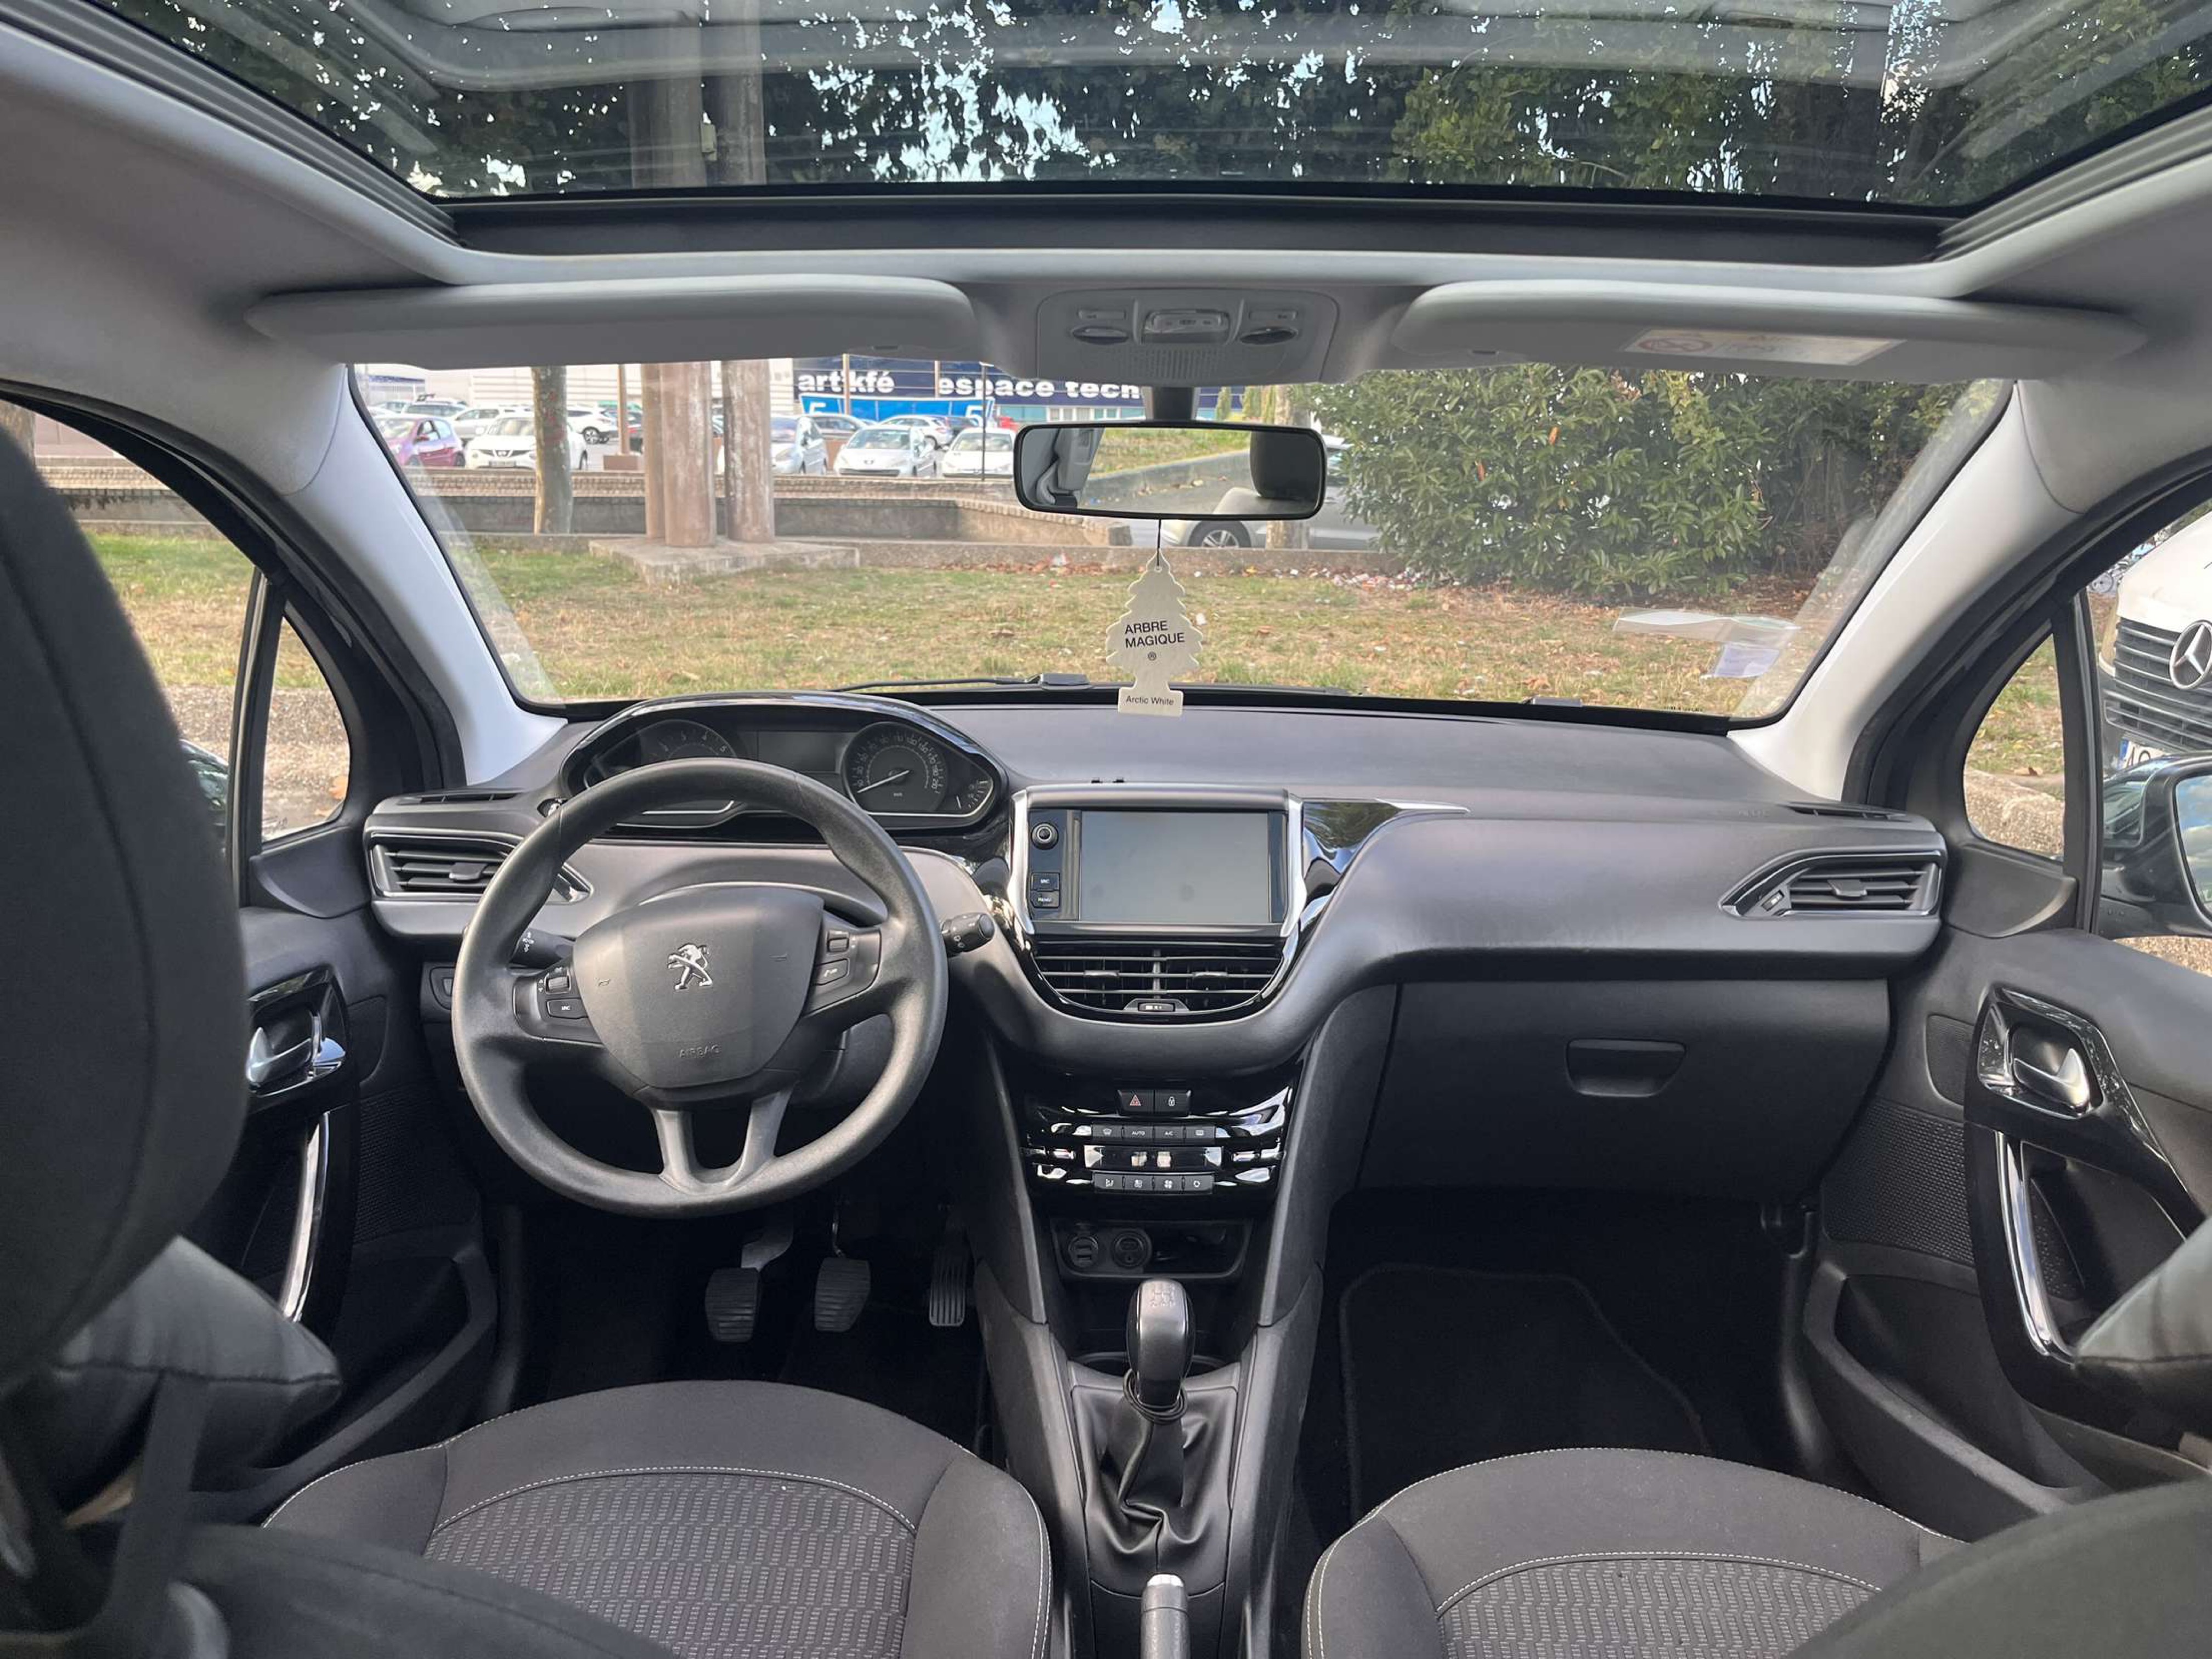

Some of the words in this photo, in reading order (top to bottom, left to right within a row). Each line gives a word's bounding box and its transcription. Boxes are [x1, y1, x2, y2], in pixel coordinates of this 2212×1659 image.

[939, 377, 1054, 397] espace
[1125, 620, 1169, 635] ARBRE
[1125, 633, 1185, 648] MAGIQUE
[1126, 695, 1149, 704] Arctic
[1150, 697, 1175, 706] White
